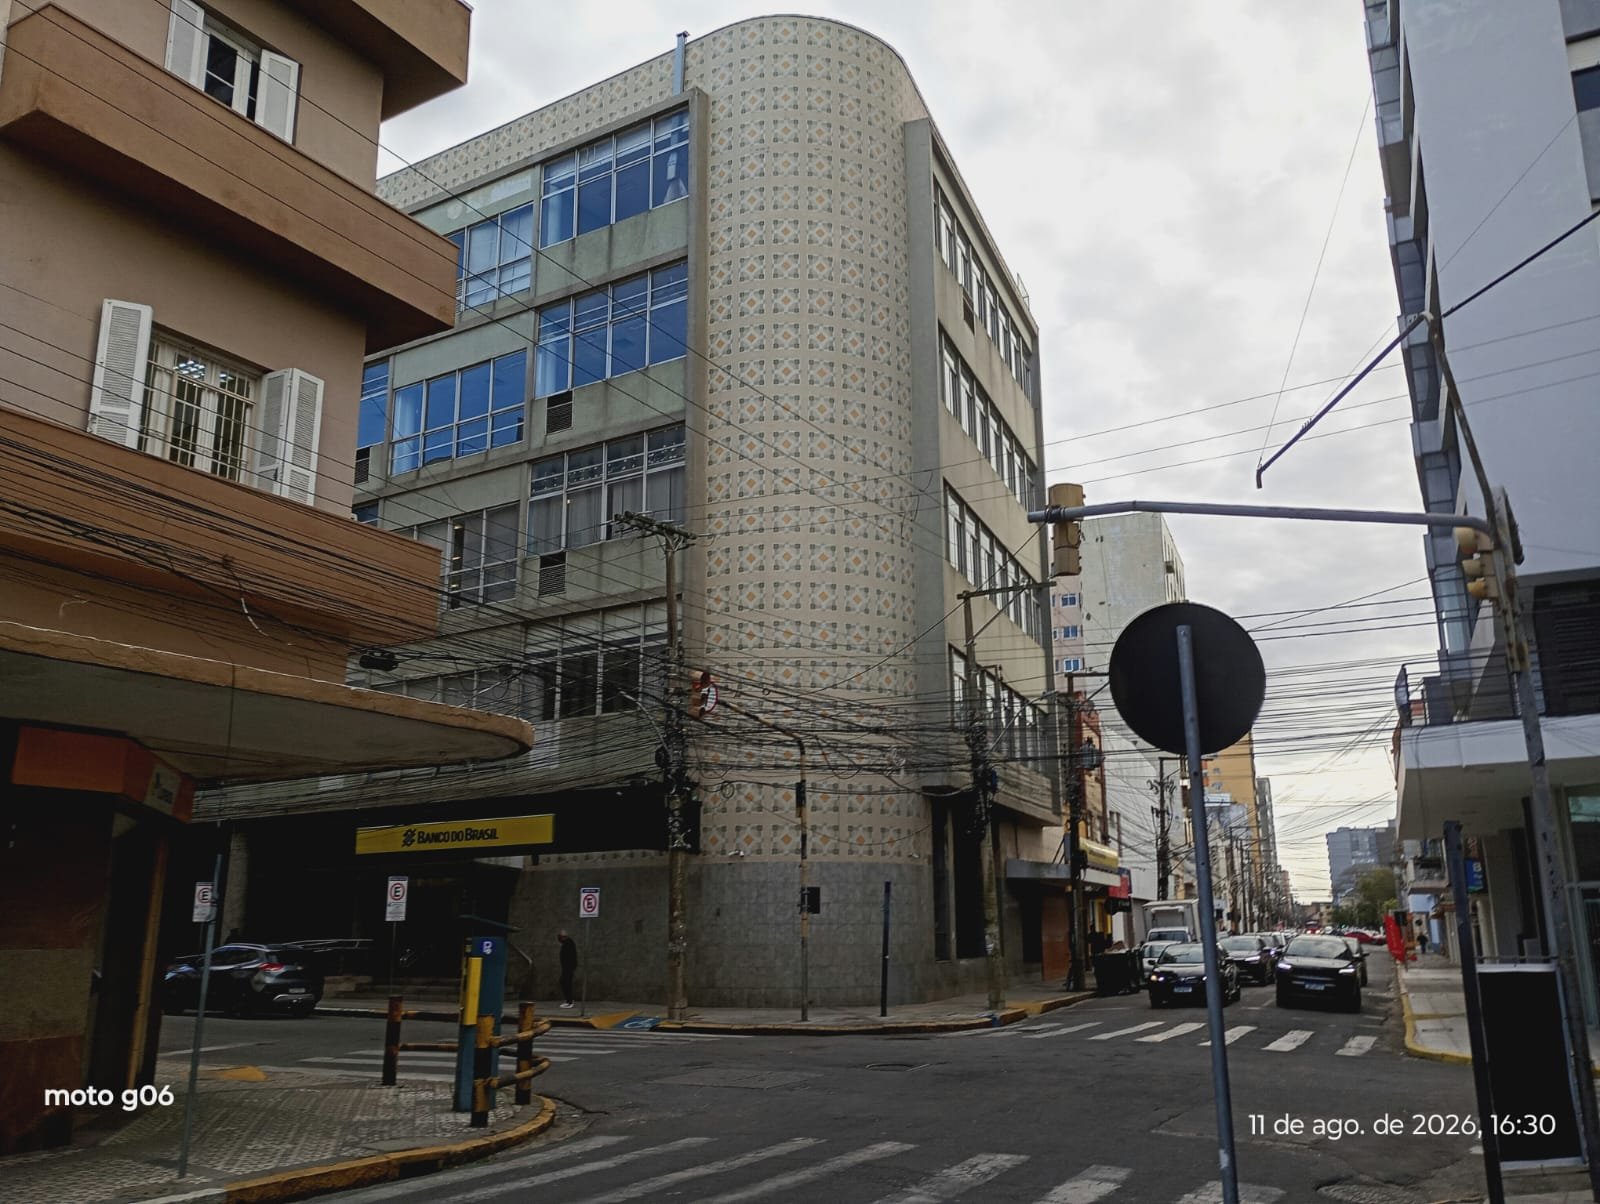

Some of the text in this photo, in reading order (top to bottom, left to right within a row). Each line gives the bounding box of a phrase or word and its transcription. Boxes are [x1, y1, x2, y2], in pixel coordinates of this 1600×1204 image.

[417, 827, 498, 844] BANCO DO BRASIL
